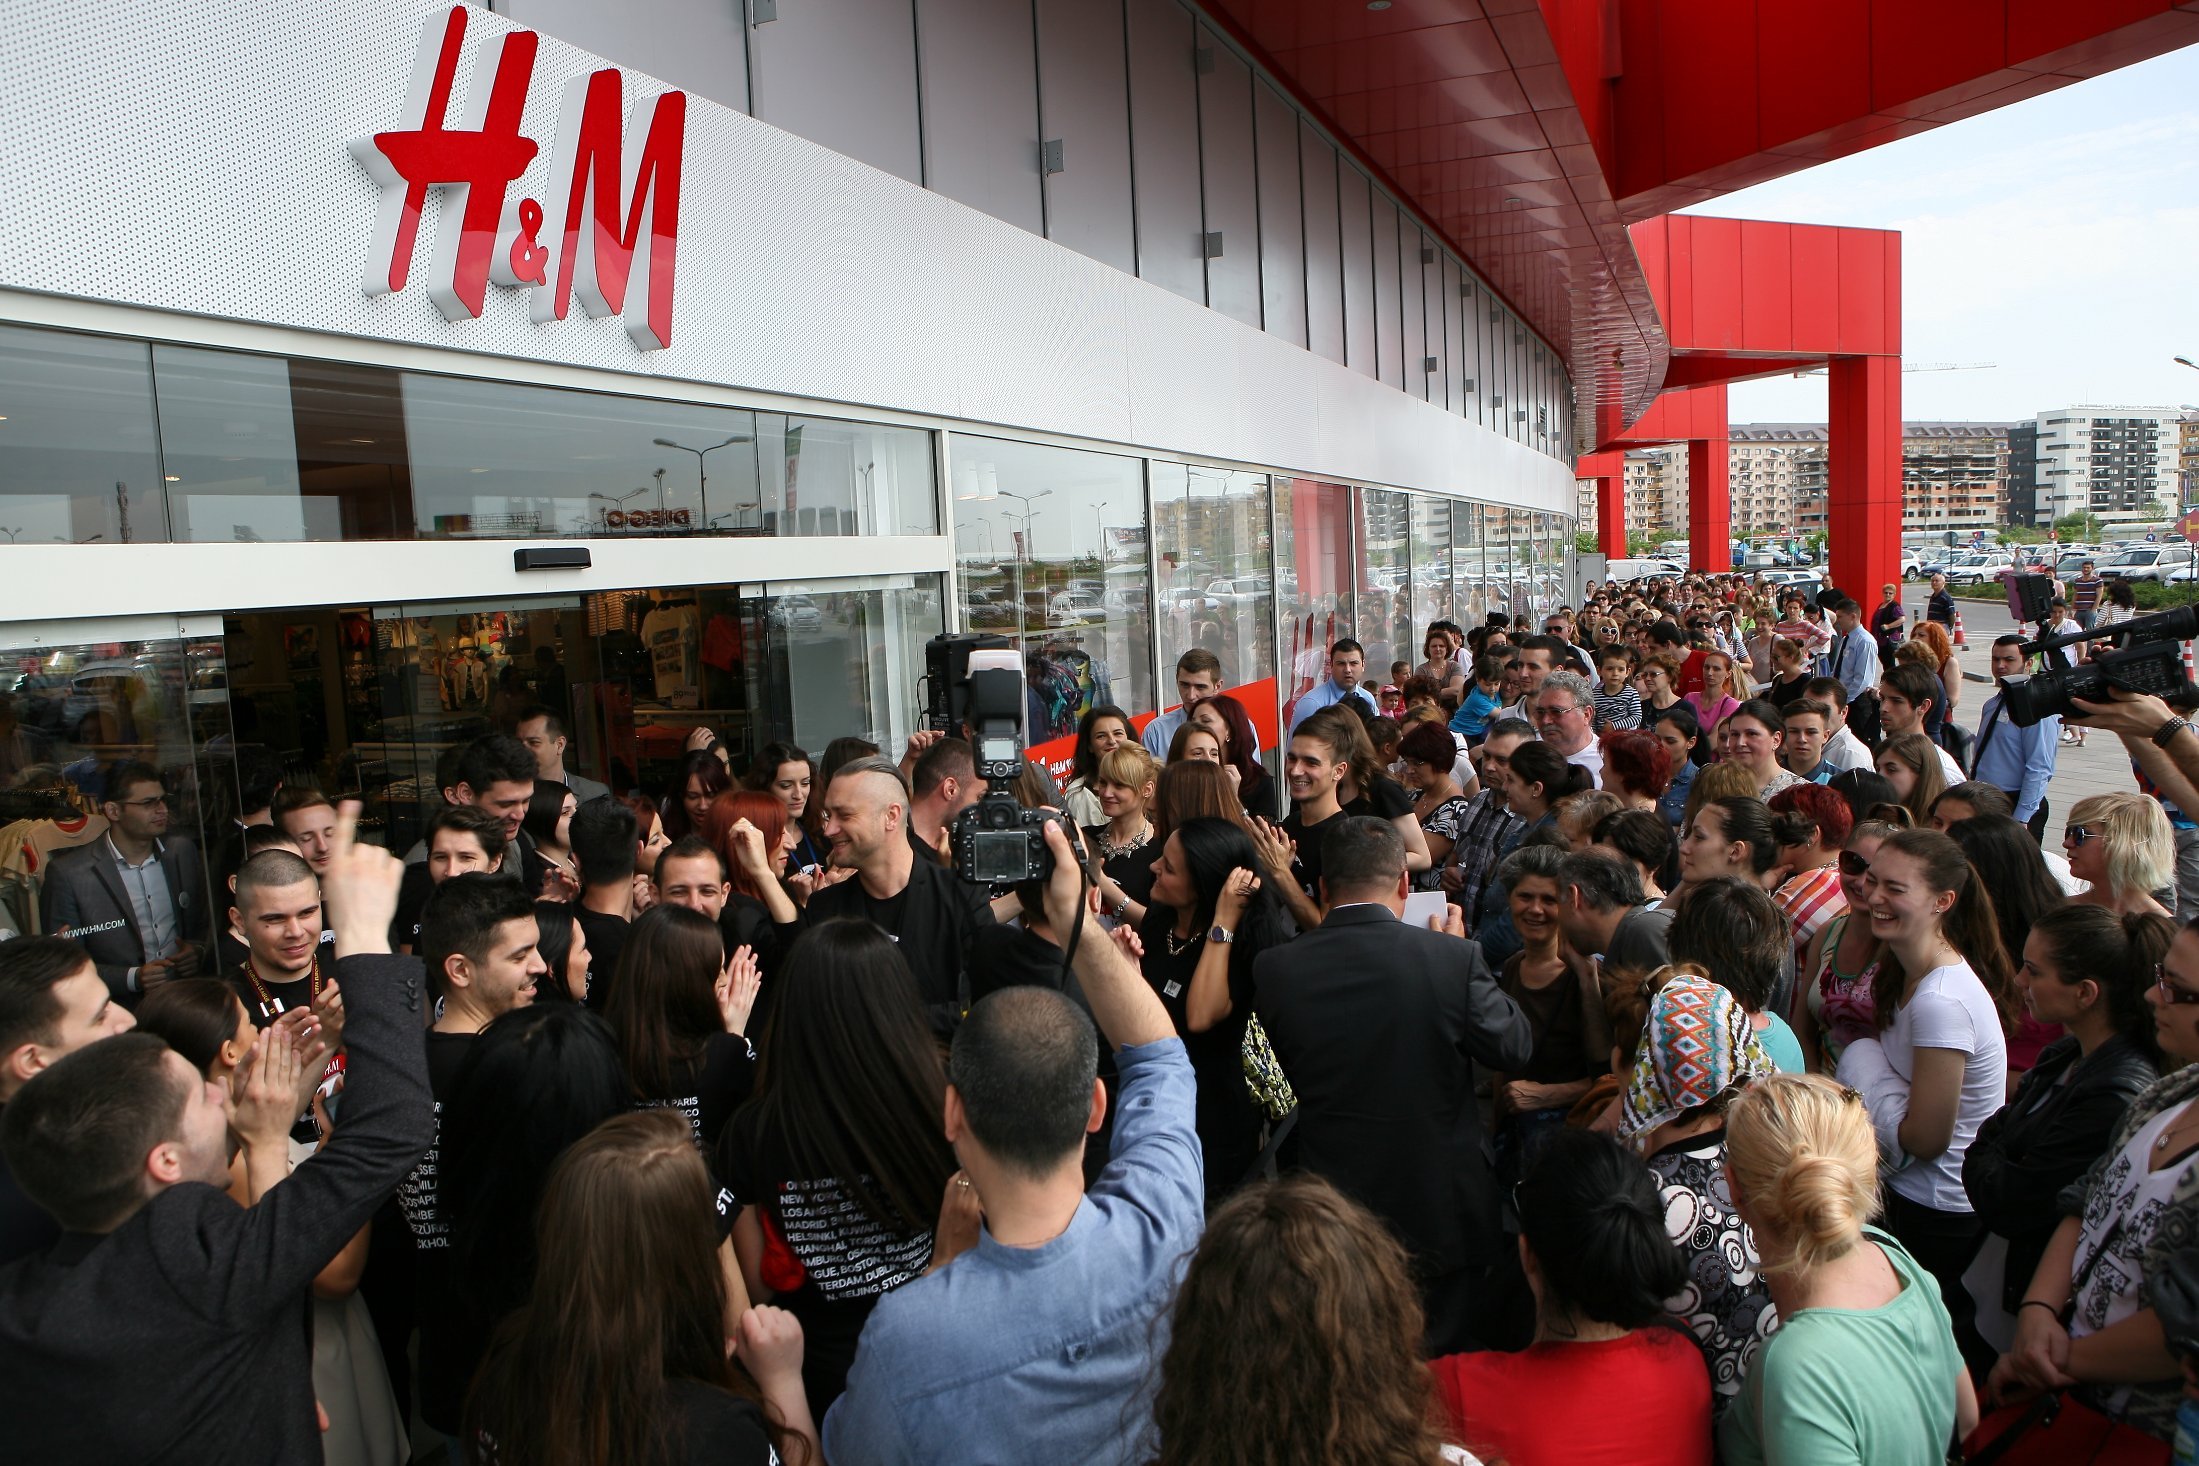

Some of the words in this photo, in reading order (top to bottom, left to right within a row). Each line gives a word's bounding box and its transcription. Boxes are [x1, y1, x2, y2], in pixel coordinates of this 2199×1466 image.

[370, 4, 686, 350] H&M
[62, 918, 126, 940] WWW.HM.COM
[671, 1096, 699, 1108] PARIS
[780, 1194, 805, 1205] NEW
